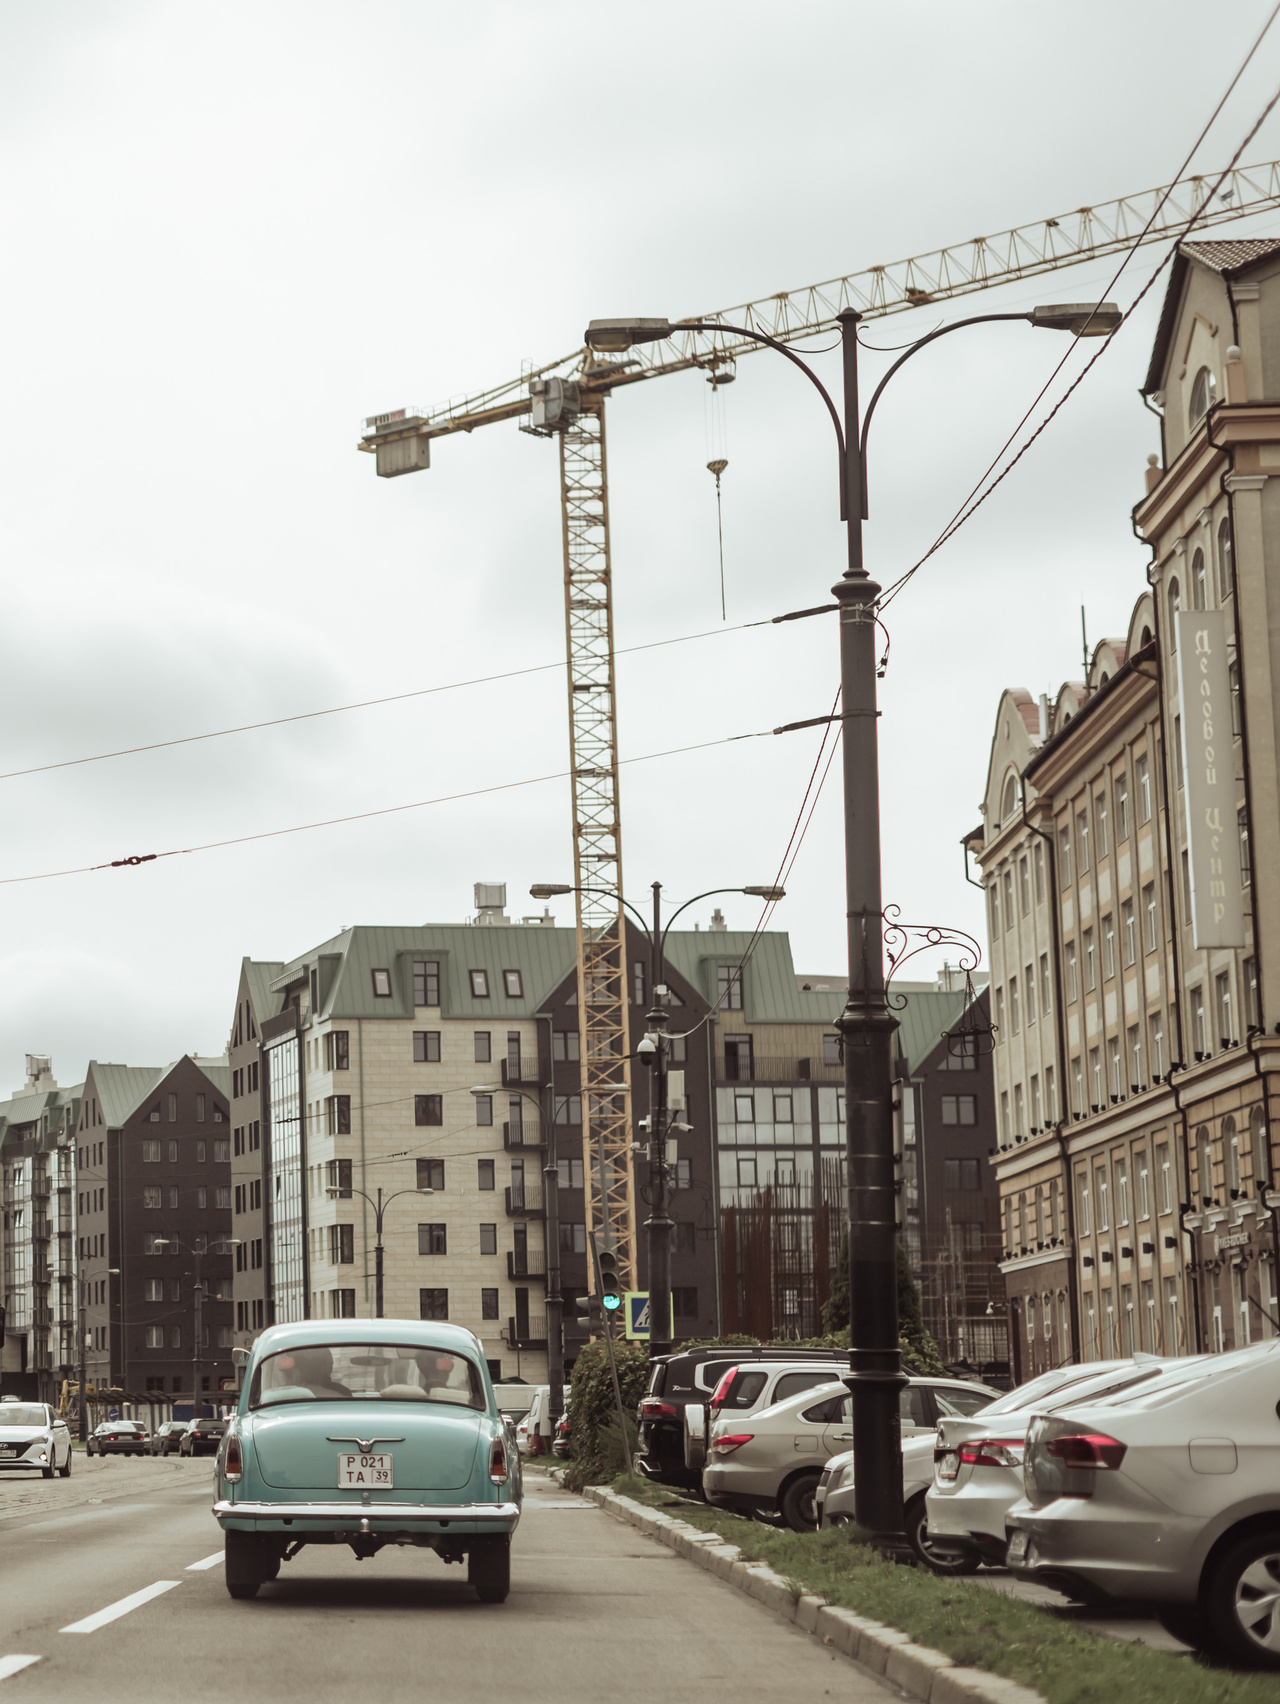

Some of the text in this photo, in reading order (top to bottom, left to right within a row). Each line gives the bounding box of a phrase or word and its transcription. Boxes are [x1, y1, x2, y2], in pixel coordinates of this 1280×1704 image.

[1195, 629, 1226, 924] Деловой Центр
[360, 1456, 384, 1468] 021
[375, 1470, 389, 1480] 39
